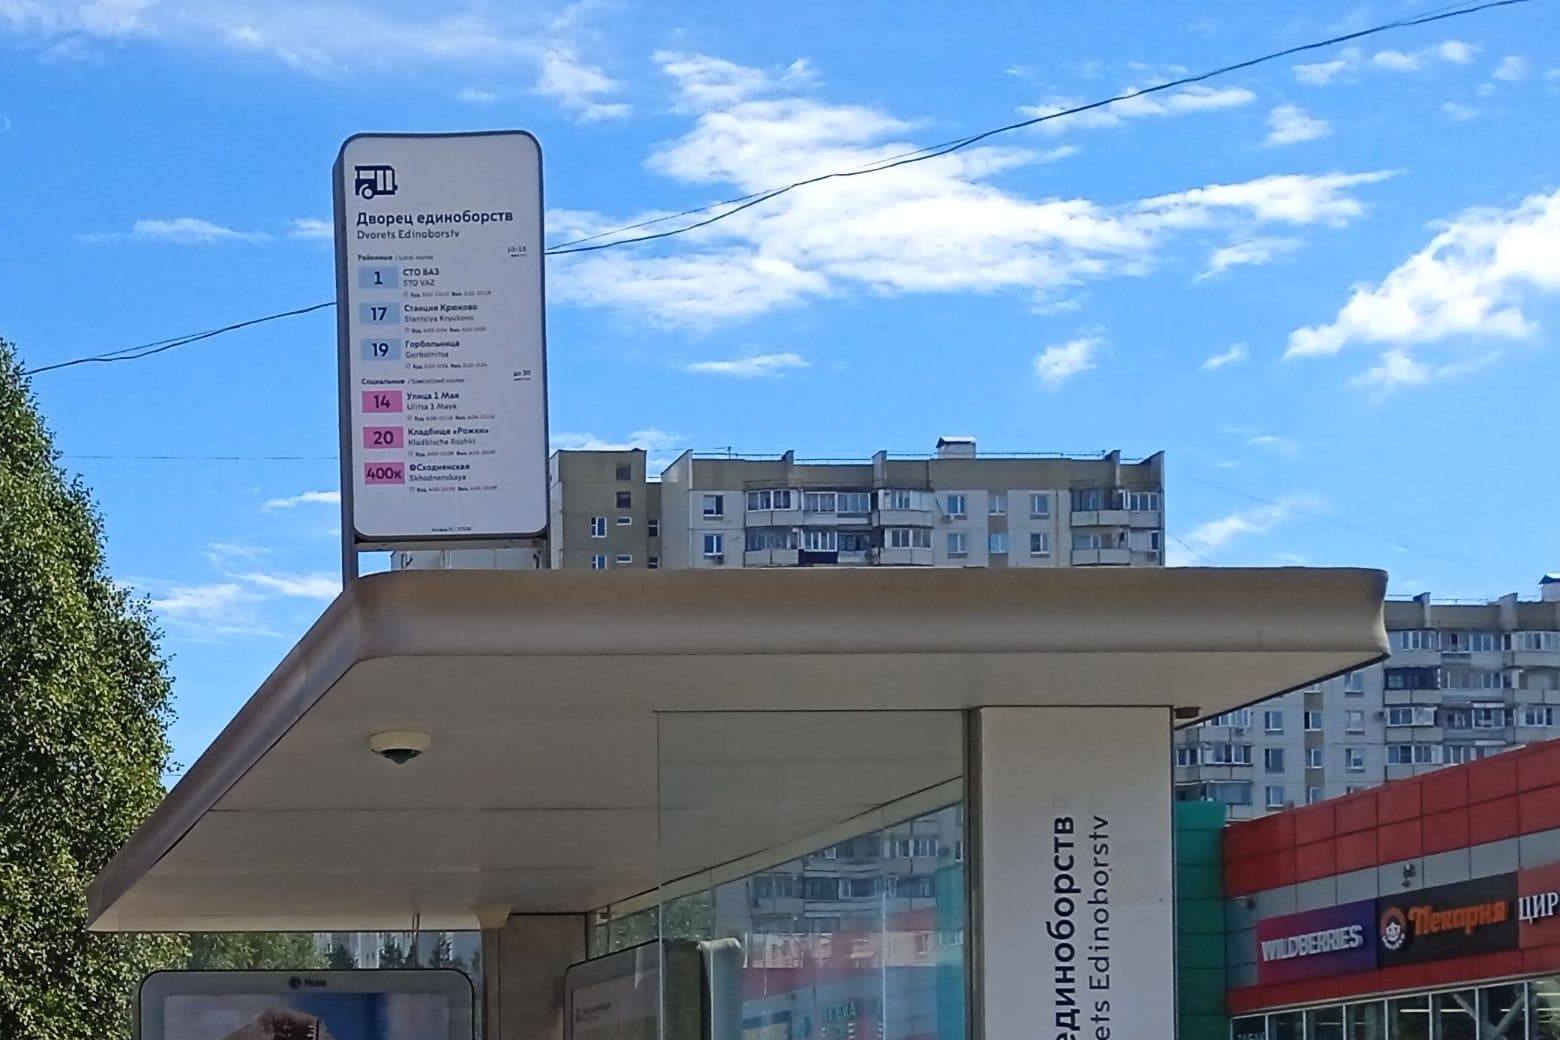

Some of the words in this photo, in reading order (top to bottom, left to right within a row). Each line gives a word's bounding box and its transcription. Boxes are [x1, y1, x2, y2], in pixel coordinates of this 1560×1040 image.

[356, 211, 414, 228] Дворец
[417, 209, 514, 226] единоборств
[357, 230, 396, 240] Dvorets
[398, 229, 460, 239] Edinoborstv
[373, 271, 384, 285] 1
[403, 268, 421, 277] СТО
[370, 306, 388, 321] 17
[403, 303, 438, 313] Станция
[440, 303, 478, 313] Крюково
[371, 342, 389, 357] 19
[405, 340, 461, 349] Горбольница
[372, 394, 391, 409] 14
[406, 392, 432, 401] Улица
[441, 391, 460, 400] Мая
[372, 430, 394, 445] 20
[407, 426, 451, 437] Кладбище
[1088, 814, 1110, 991] Edinoborstv
[1407, 900, 1509, 936] Пекарня
[1260, 924, 1364, 963] WILDBERRIES
